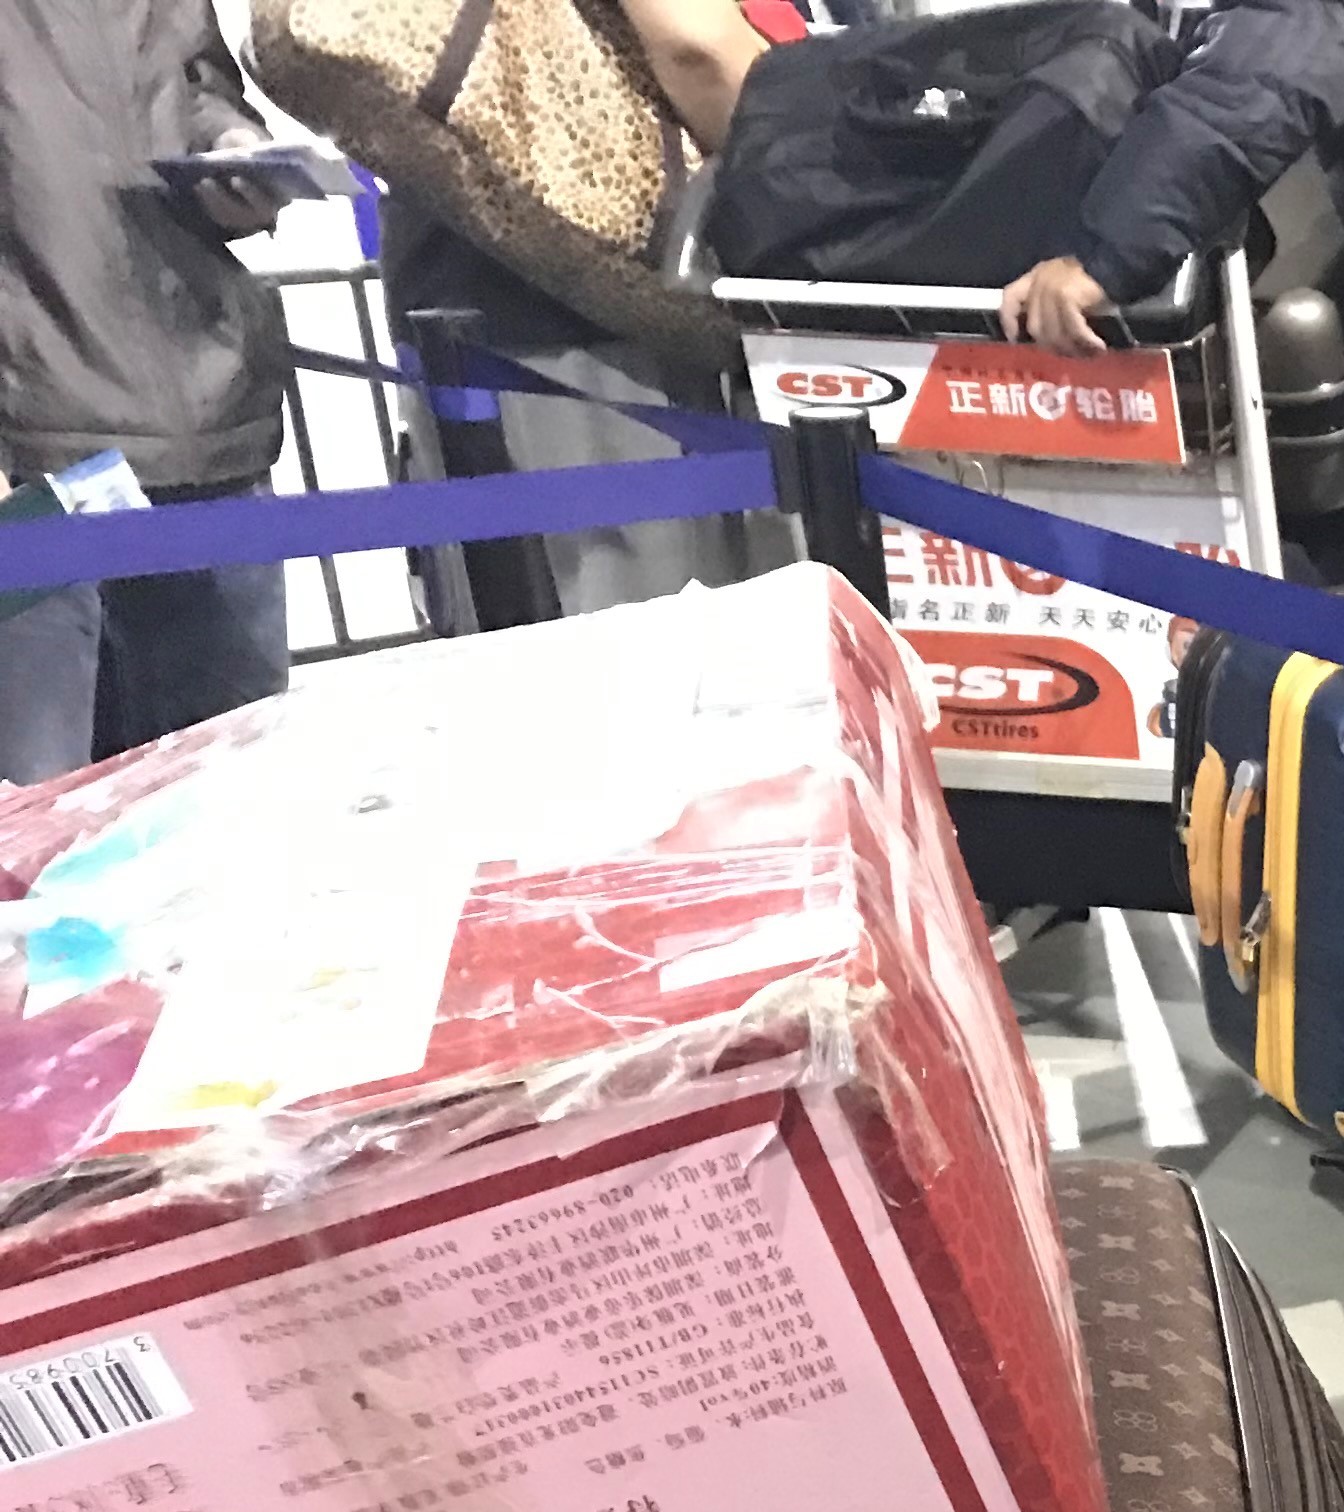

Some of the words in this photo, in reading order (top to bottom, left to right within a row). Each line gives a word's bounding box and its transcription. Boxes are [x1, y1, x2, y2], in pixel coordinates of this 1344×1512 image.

[776, 371, 873, 400] CST
[1039, 606, 1163, 635] 天天安心
[927, 665, 1054, 702] CST
[952, 718, 1040, 740] CSTtires
[133, 1335, 151, 1353] 3
